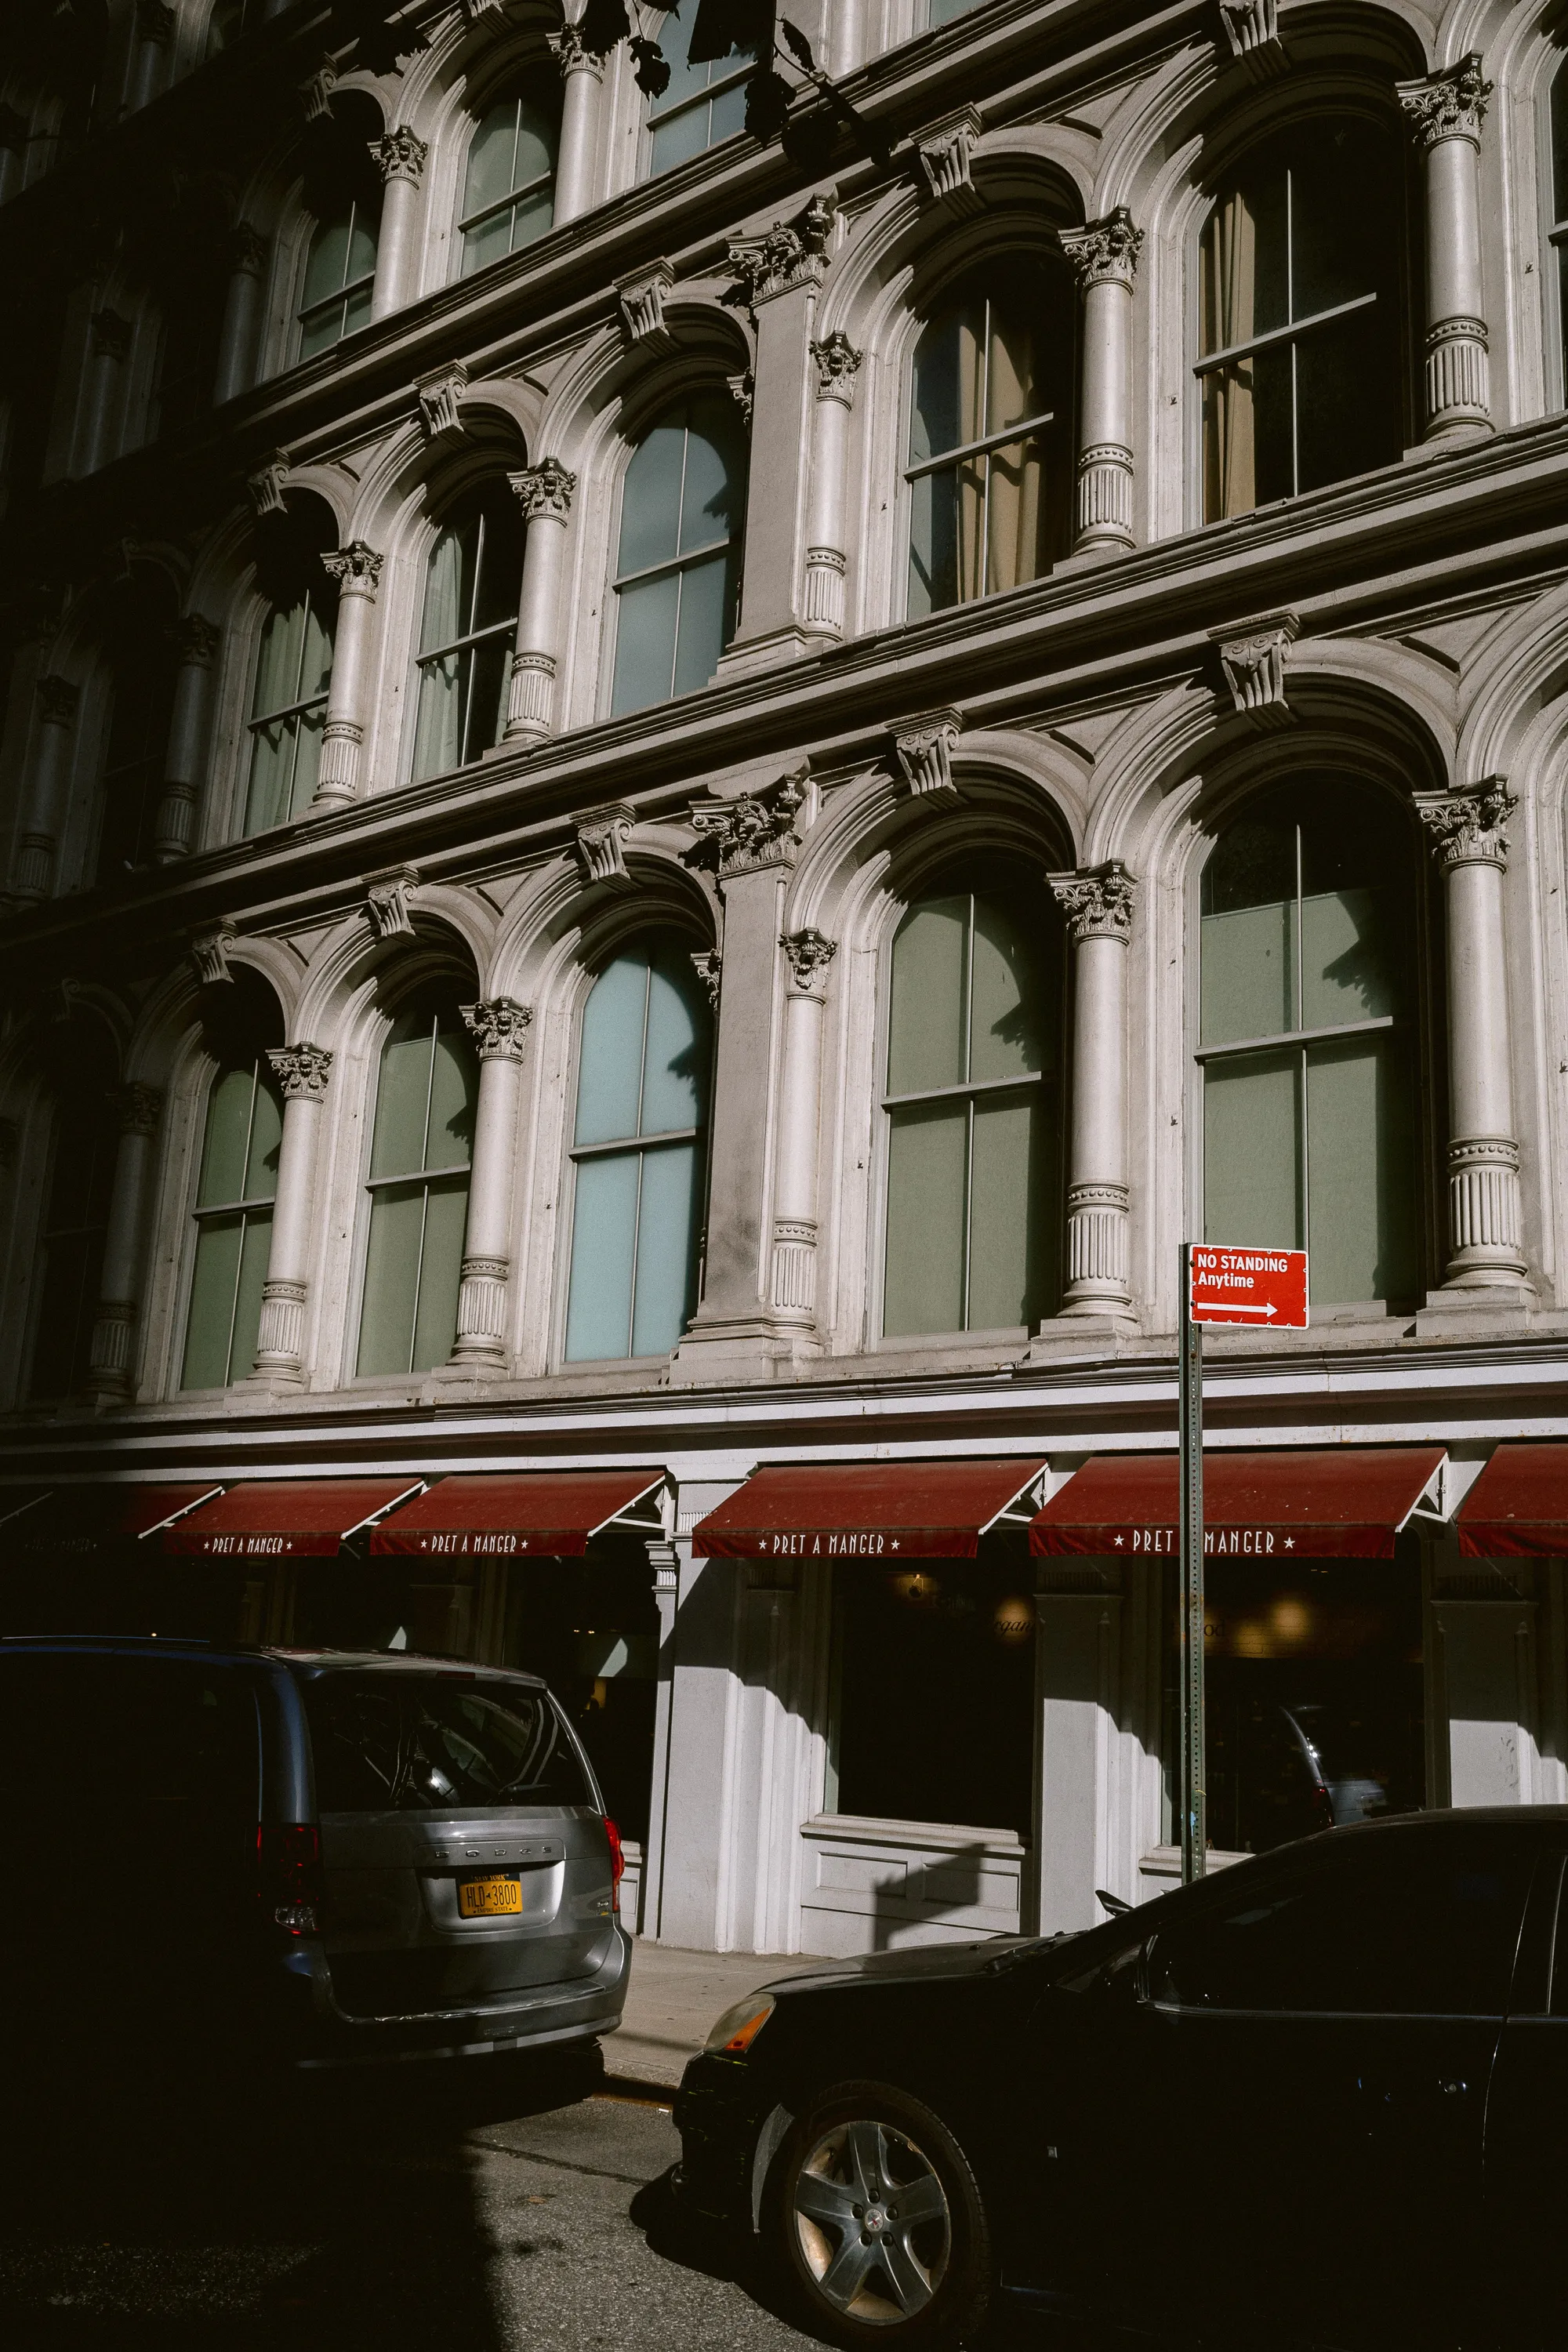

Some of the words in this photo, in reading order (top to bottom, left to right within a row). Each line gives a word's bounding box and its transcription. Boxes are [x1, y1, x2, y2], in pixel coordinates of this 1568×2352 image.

[1197, 1254, 1217, 1269] NO
[1220, 1255, 1288, 1273] STANDING
[1198, 1271, 1254, 1290] Anytime
[212, 1537, 235, 1553] PRET
[237, 1537, 243, 1553] A
[247, 1537, 283, 1553] MANGER
[431, 1535, 457, 1552] PRET
[461, 1535, 468, 1552] A
[474, 1535, 517, 1553] MANGER
[773, 1534, 806, 1554] PRET
[812, 1534, 820, 1554] A
[829, 1534, 884, 1554] MANGER
[1133, 1530, 1174, 1552] PRET
[1203, 1530, 1274, 1554] MANGER
[435, 1846, 552, 1857] DODGE
